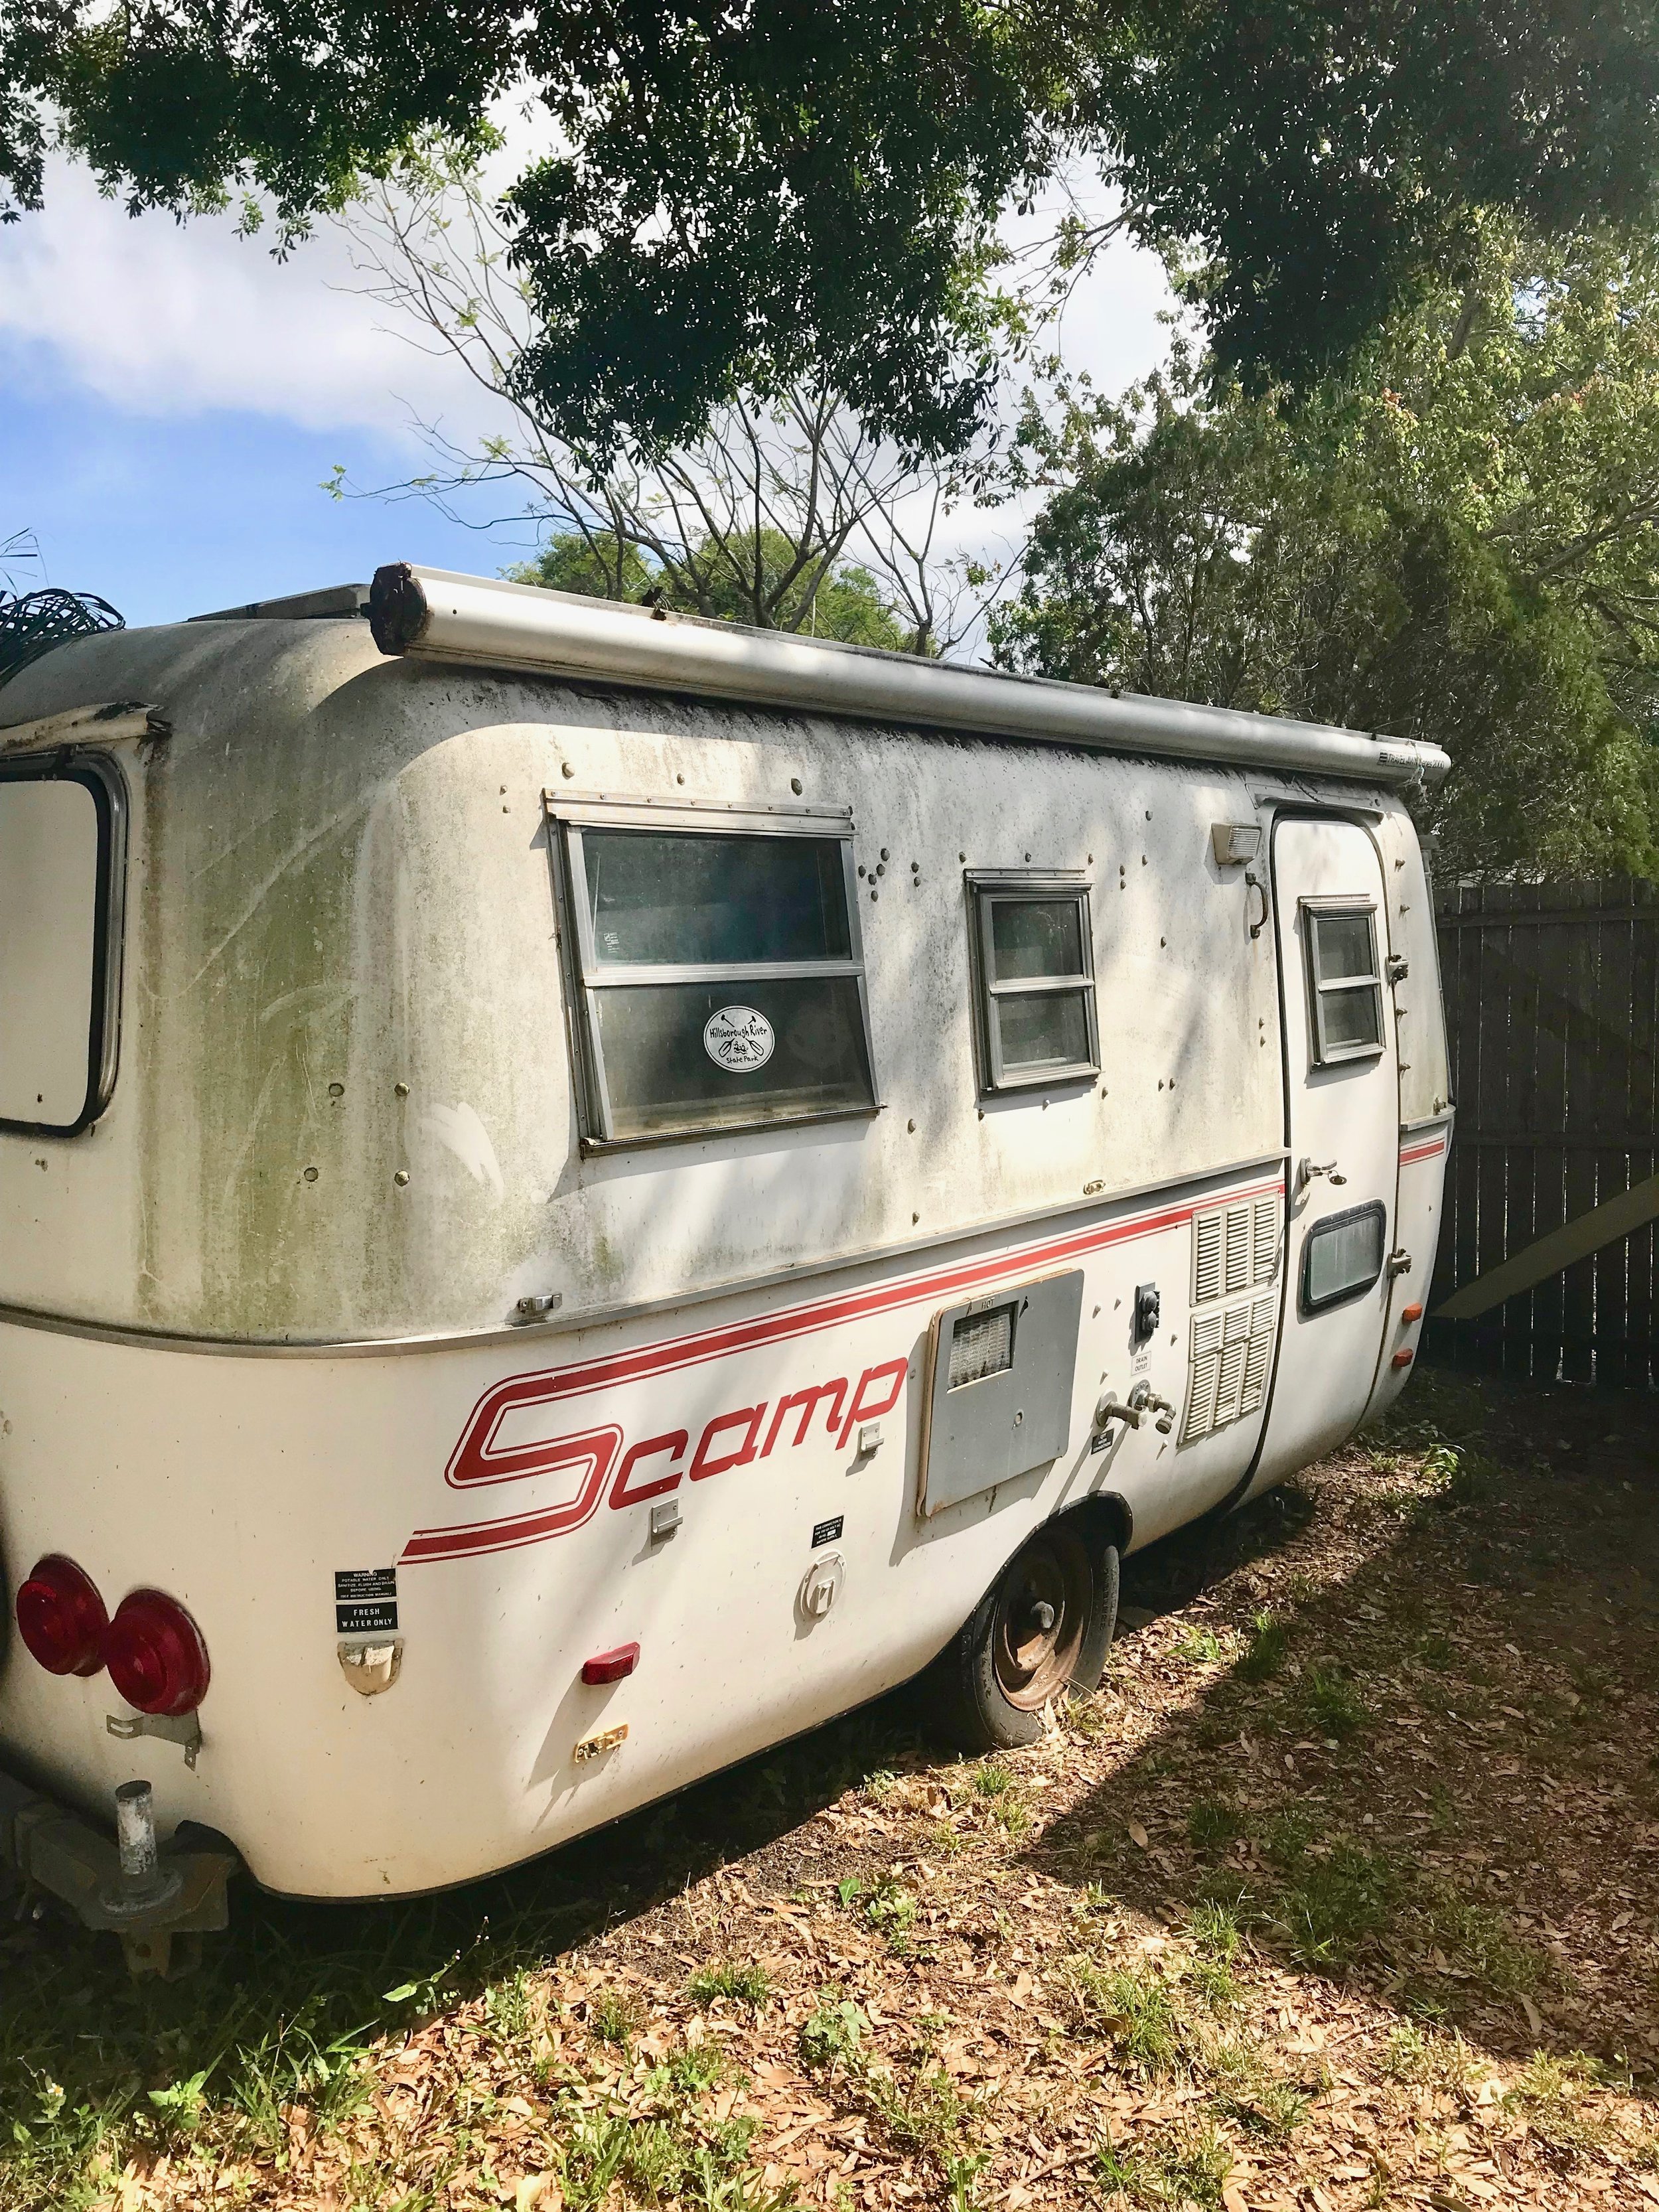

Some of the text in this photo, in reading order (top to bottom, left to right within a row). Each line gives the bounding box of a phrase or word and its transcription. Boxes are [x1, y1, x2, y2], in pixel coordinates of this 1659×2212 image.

[710, 1025, 767, 1038] Hillsborough River
[981, 1297, 995, 1310] HOT
[1135, 1363, 1147, 1371] OUTLET
[399, 1357, 908, 1565] Scamp
